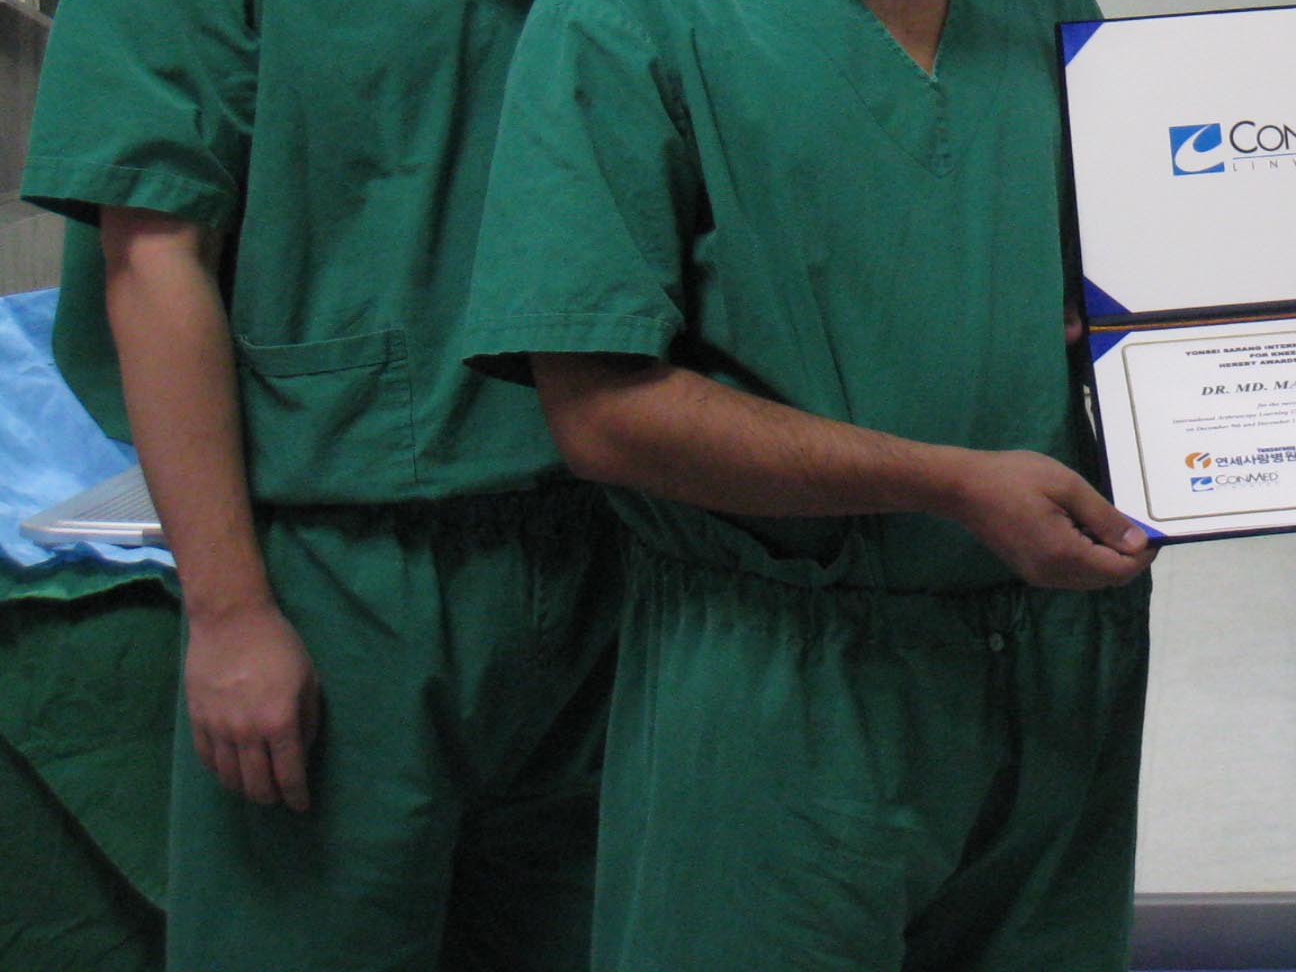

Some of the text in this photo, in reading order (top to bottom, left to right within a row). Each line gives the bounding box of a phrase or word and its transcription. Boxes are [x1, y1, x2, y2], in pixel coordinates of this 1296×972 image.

[1219, 360, 1257, 368] HEREBY
[1201, 384, 1231, 396] DR.
[1235, 381, 1269, 394] MD.
